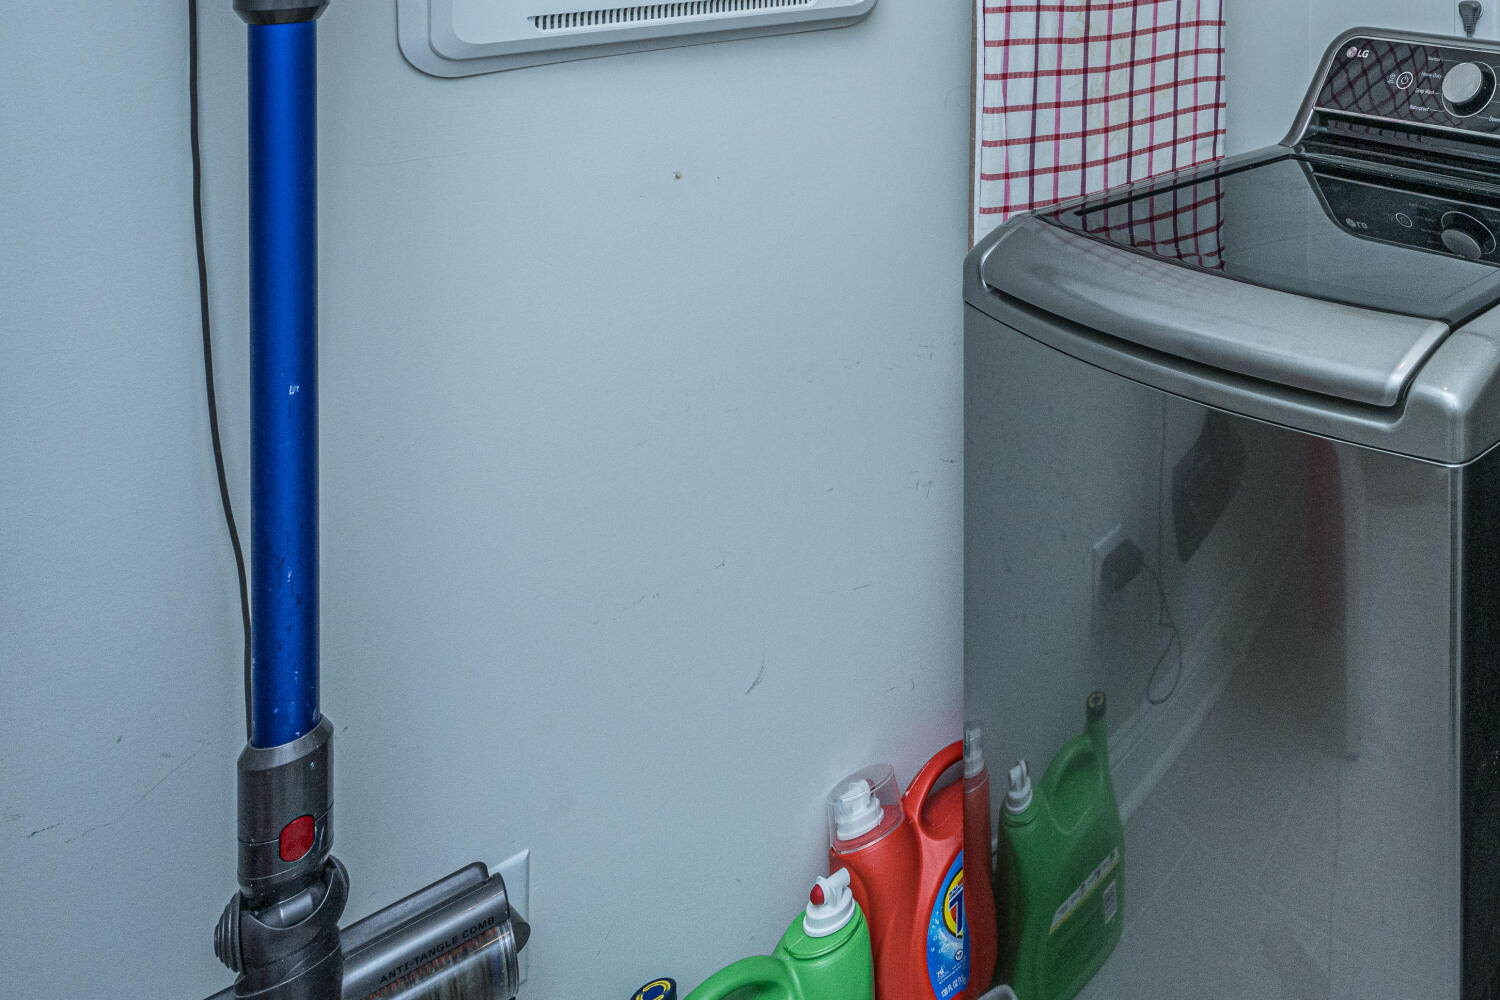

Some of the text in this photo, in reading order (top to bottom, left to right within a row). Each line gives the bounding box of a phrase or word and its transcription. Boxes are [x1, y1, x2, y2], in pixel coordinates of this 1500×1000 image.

[1357, 49, 1369, 58] LG
[380, 916, 495, 983] ANTI-TANGLE COMB
